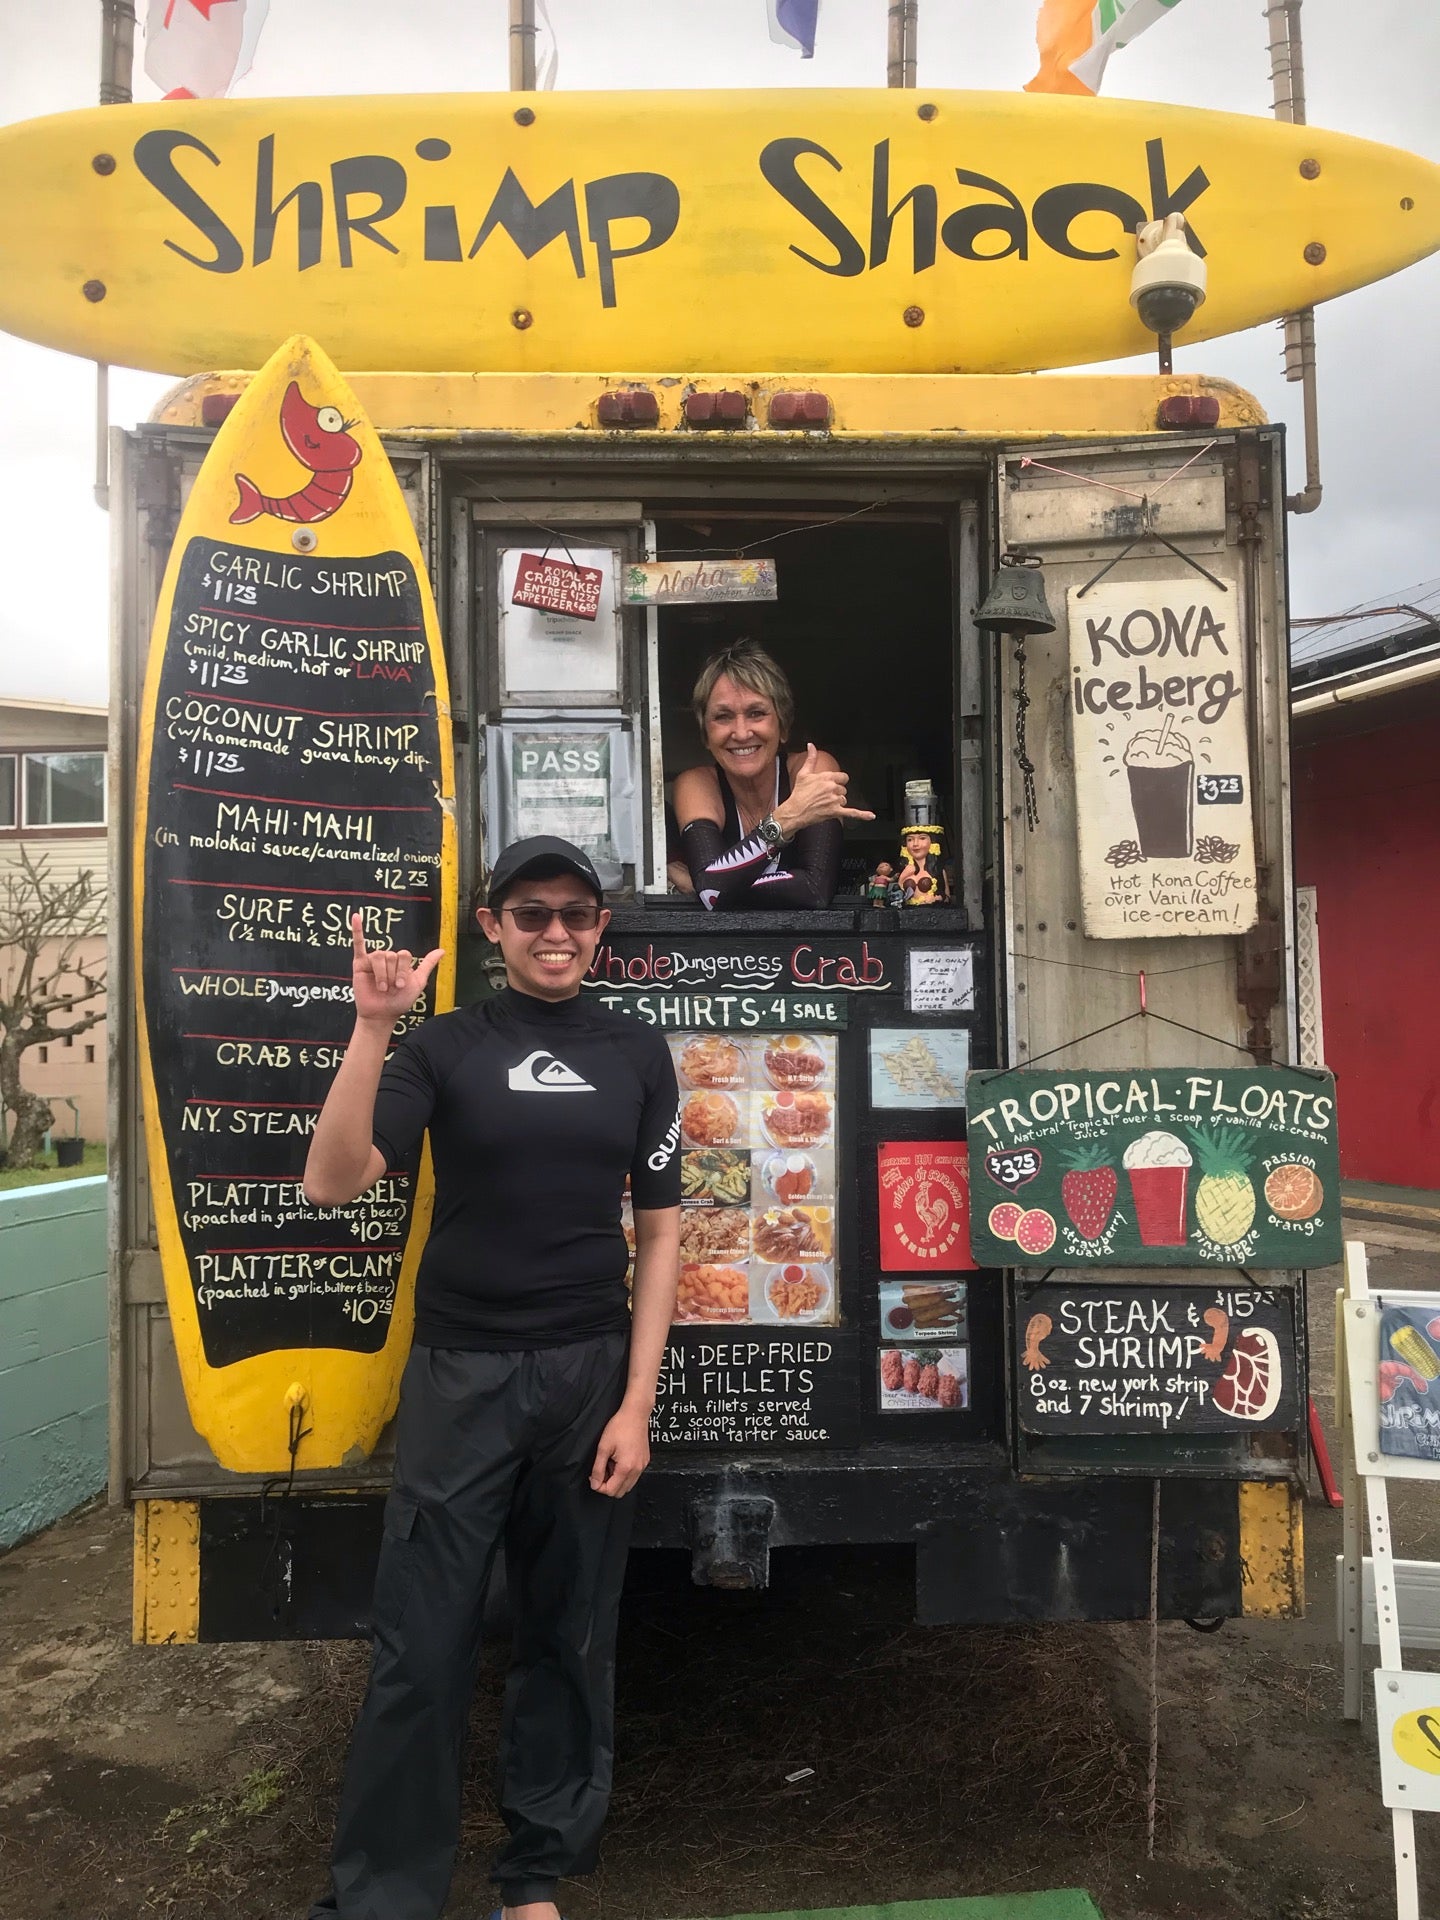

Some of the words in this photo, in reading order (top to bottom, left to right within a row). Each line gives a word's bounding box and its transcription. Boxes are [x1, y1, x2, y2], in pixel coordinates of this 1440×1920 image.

[759, 137, 1211, 277] Shack
[210, 551, 302, 590] GARLIC
[310, 570, 408, 598] SHRIMP
[524, 570, 560, 588] CRAB
[561, 579, 600, 595] CAKES
[544, 566, 580, 582] ROYAL
[655, 562, 727, 595] Aloha
[513, 590, 574, 612] APPETIZER
[523, 582, 567, 600] ENTREE
[183, 613, 251, 645] SPICY
[260, 627, 348, 660] GARLIC
[352, 639, 426, 665] SHRIMP
[1086, 604, 1230, 667] KONA
[184, 639, 230, 662] (mild,
[234, 650, 300, 674] medium,
[301, 658, 331, 677] hot
[334, 665, 353, 678] or
[1073, 665, 1243, 725] iceberg
[166, 696, 304, 741] COCONUT
[312, 720, 420, 751] SHRIMP
[300, 748, 351, 766] guava
[354, 748, 400, 774] honey
[521, 750, 601, 773] PASS
[154, 826, 181, 848] (in
[189, 830, 258, 854] molokai
[1110, 874, 1142, 891] Hot
[1152, 872, 1194, 889] Kona
[1195, 870, 1254, 897] Coffee
[216, 893, 294, 925] SURF
[301, 901, 316, 928] &
[1104, 892, 1142, 908] over
[1149, 889, 1214, 906] Vanilla
[1122, 903, 1241, 924] ice-cream!
[260, 924, 302, 944] mahi
[326, 931, 395, 953] shrmp)
[671, 951, 783, 980] Dungeness
[790, 941, 886, 985] Crab
[793, 1001, 839, 1021] SALE
[216, 1042, 292, 1067] CRAB
[299, 1048, 310, 1067] &
[1186, 1075, 1333, 1130] FLOATS
[1013, 1124, 1060, 1146] Natural
[1122, 1112, 1147, 1125] over
[1153, 1113, 1163, 1123] a
[1169, 1113, 1204, 1131] scoop
[1210, 1112, 1223, 1127] of
[1225, 1113, 1263, 1130] vanilla
[1262, 1152, 1317, 1173] passion
[186, 1182, 310, 1208] PLATTER
[183, 1208, 258, 1232] (poached
[260, 1209, 273, 1224] in
[370, 1204, 407, 1220] beer)
[1267, 1213, 1325, 1237] orange
[1063, 1242, 1116, 1259] guava
[1190, 1228, 1261, 1255] pineapple
[194, 1253, 313, 1283] PLATTER
[197, 1282, 270, 1311] (poached
[273, 1282, 285, 1295] in
[364, 1278, 396, 1297] beer)
[1060, 1299, 1175, 1335] STEAK
[1187, 1302, 1201, 1328] &
[659, 1345, 685, 1370] EN
[1075, 1336, 1207, 1370] SHRIMP
[702, 1368, 814, 1396] FILLETS
[1030, 1373, 1047, 1397] 8
[1078, 1377, 1118, 1393] new
[1121, 1374, 1161, 1402] york
[1165, 1373, 1210, 1406] strip
[671, 1400, 698, 1414] fish
[705, 1398, 749, 1413] fillets
[757, 1398, 812, 1413] served
[887, 1399, 932, 1407] OYSTERS
[1035, 1394, 1072, 1415] and
[1079, 1394, 1093, 1416] 7
[650, 1427, 720, 1443] Hawaiian
[726, 1427, 778, 1442] tarter
[785, 1428, 831, 1441] sauce.
[669, 1416, 680, 1429] 2
[688, 1414, 737, 1432] scoops
[745, 1412, 773, 1427] rice
[779, 1411, 810, 1427] and
